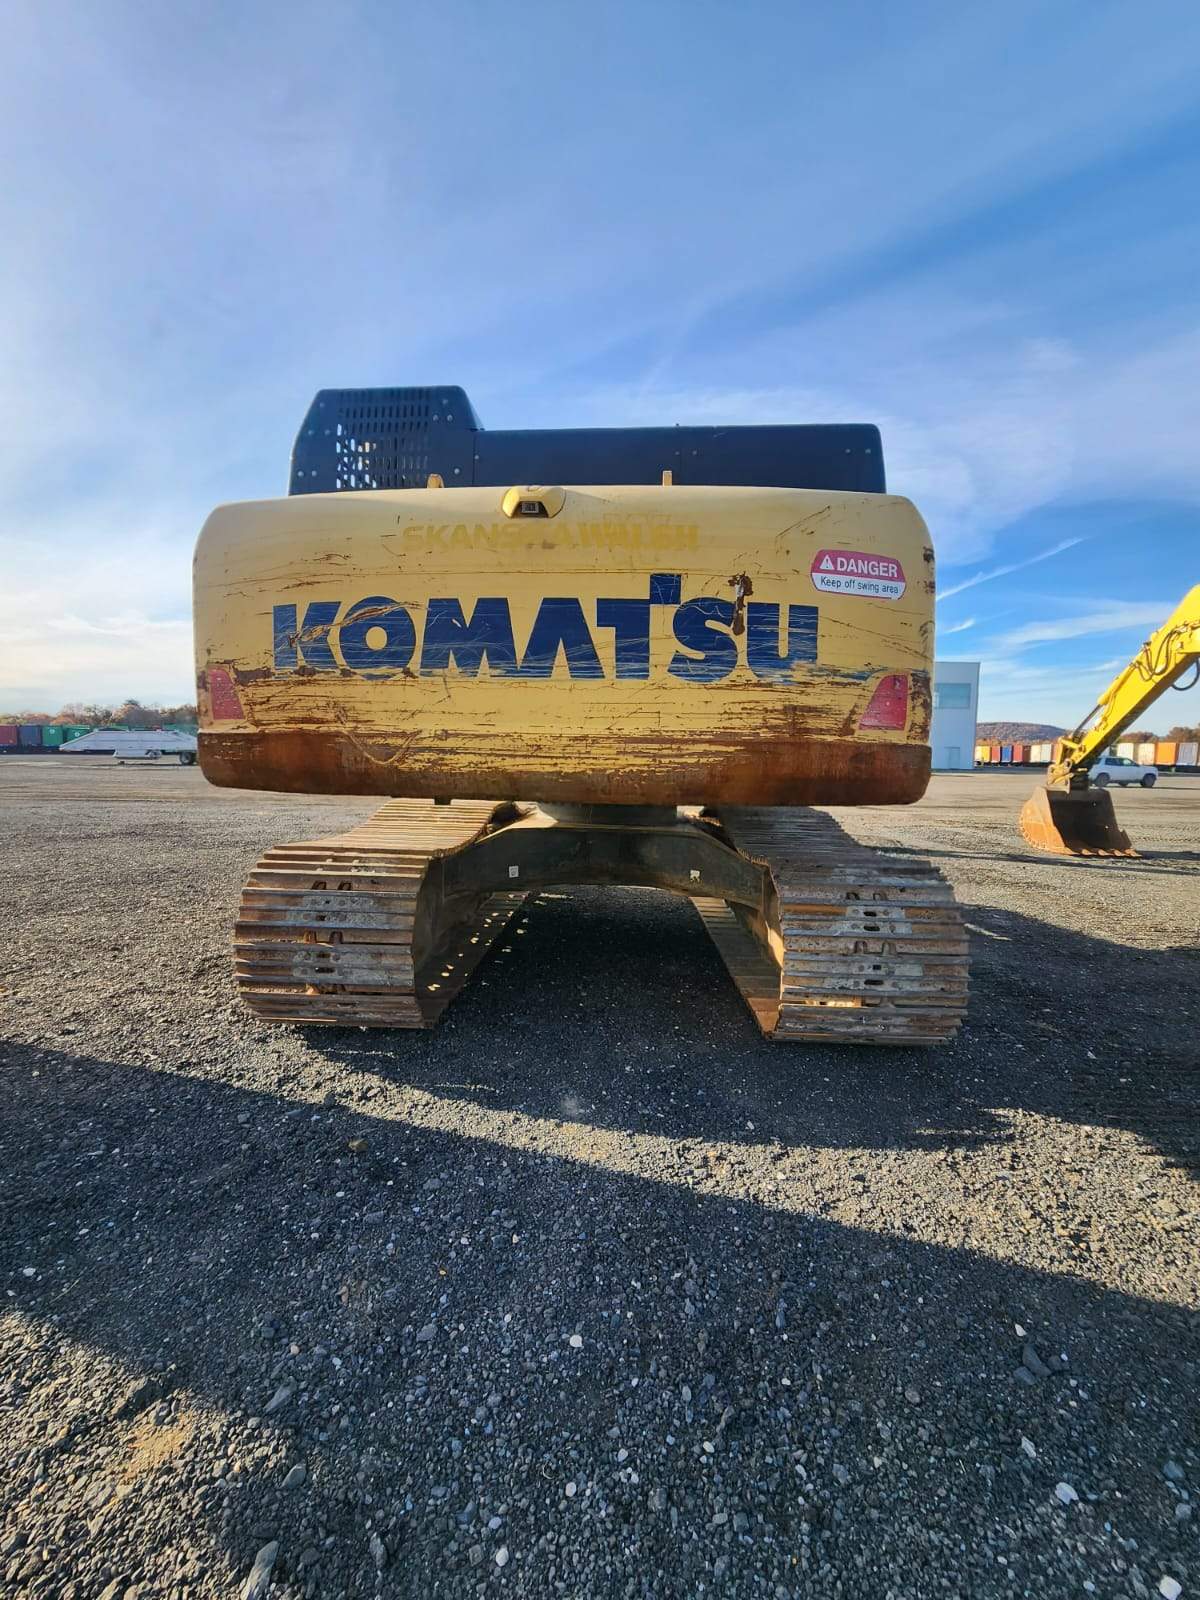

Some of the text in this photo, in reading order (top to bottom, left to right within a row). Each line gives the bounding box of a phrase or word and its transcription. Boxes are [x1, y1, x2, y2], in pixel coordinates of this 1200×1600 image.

[836, 557, 898, 578] DANGER
[820, 575, 899, 594] Keep off swing area
[273, 573, 819, 684] KOMATSU
